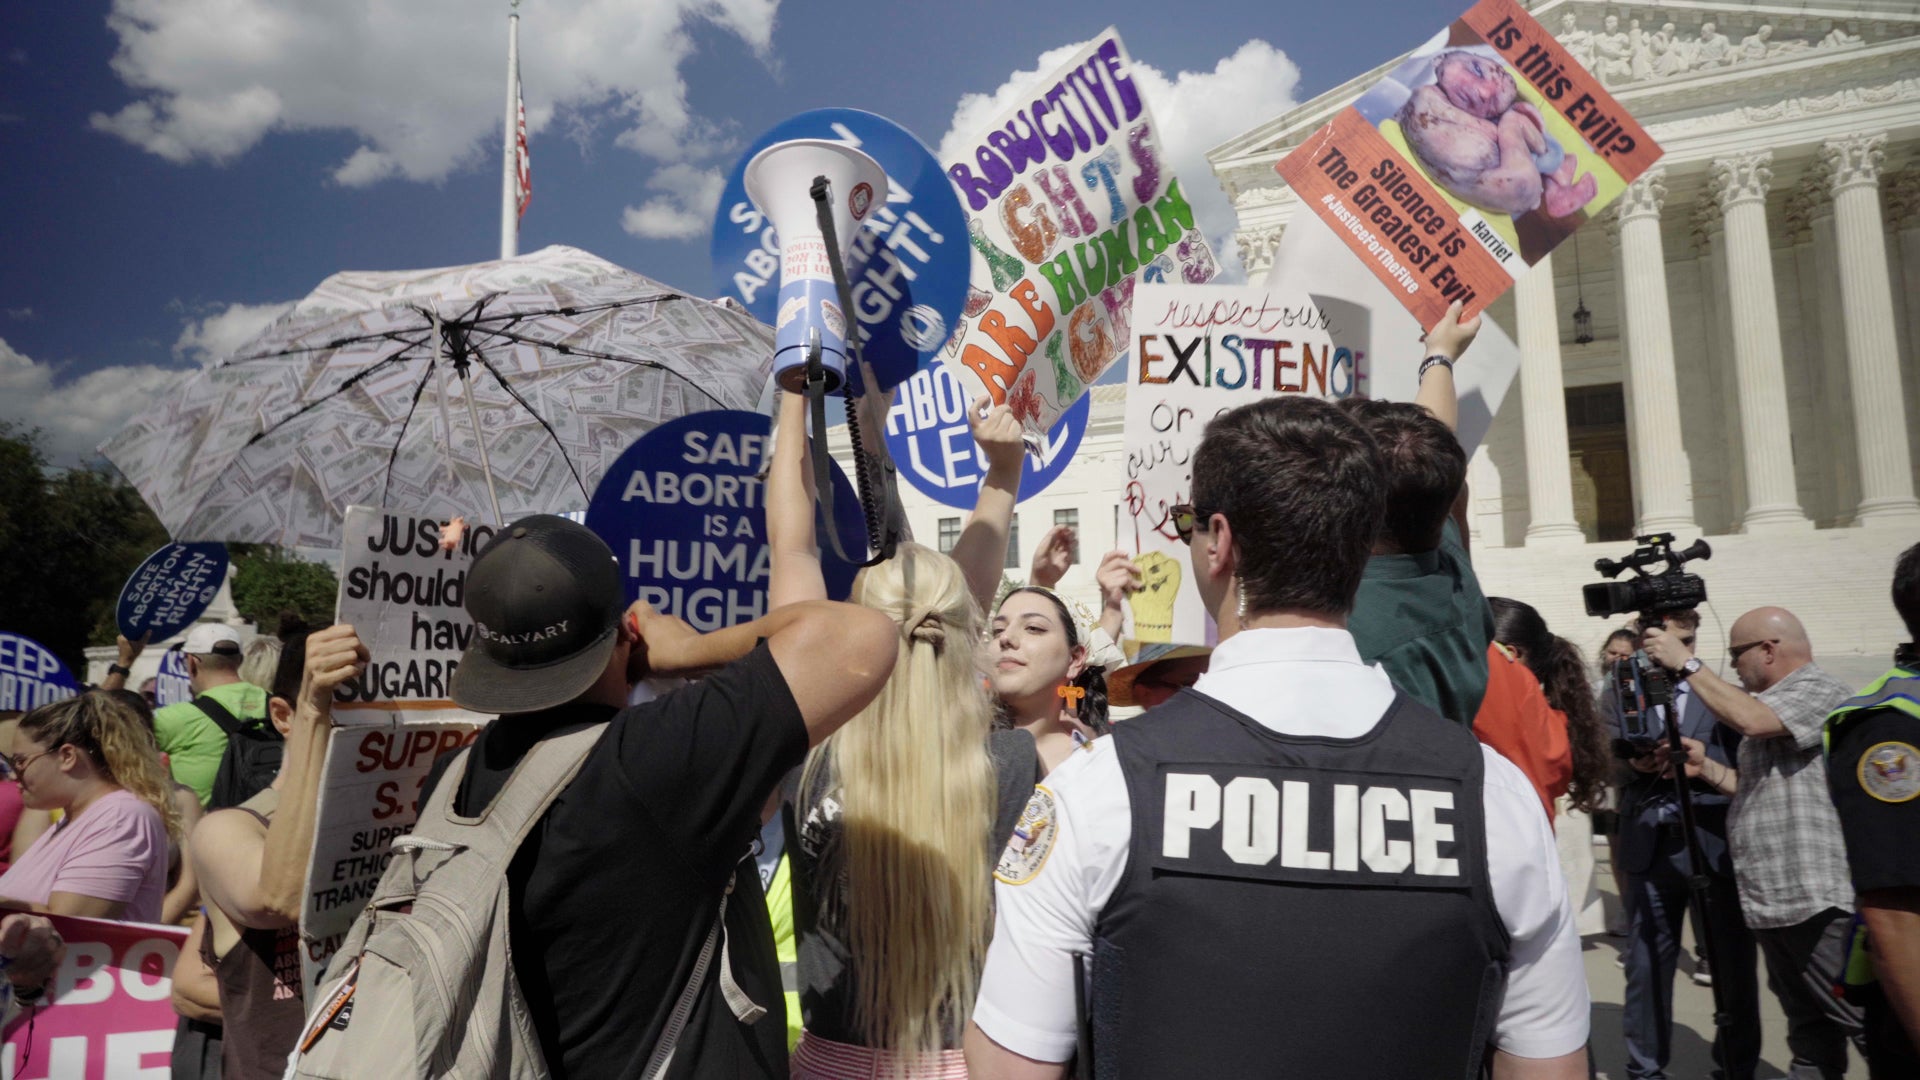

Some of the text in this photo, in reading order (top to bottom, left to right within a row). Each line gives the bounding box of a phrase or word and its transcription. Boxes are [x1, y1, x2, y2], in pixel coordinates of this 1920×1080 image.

[1487, 16, 1636, 157] Is this Evil?
[1318, 147, 1477, 306] The Greatest Evil
[1370, 159, 1466, 258] Silence is
[1321, 193, 1419, 294] #JusticeForTheFive
[1472, 220, 1513, 263] Harriet
[961, 177, 1195, 406] ARE HUMAN
[1155, 293, 1339, 337] respect our
[1139, 334, 1368, 398] EXISTENCE
[704, 514, 755, 538] IS A
[128, 563, 160, 602] SAFE
[128, 545, 187, 627] ABORTION
[150, 552, 206, 626] HUMAN
[158, 587, 168, 597] IS
[166, 559, 218, 624] RIGHT!
[347, 561, 465, 608] should
[0, 634, 60, 679] EEP
[410, 611, 474, 650] hav
[489, 620, 569, 645] CALVARY
[1162, 772, 1460, 876] POLICE
